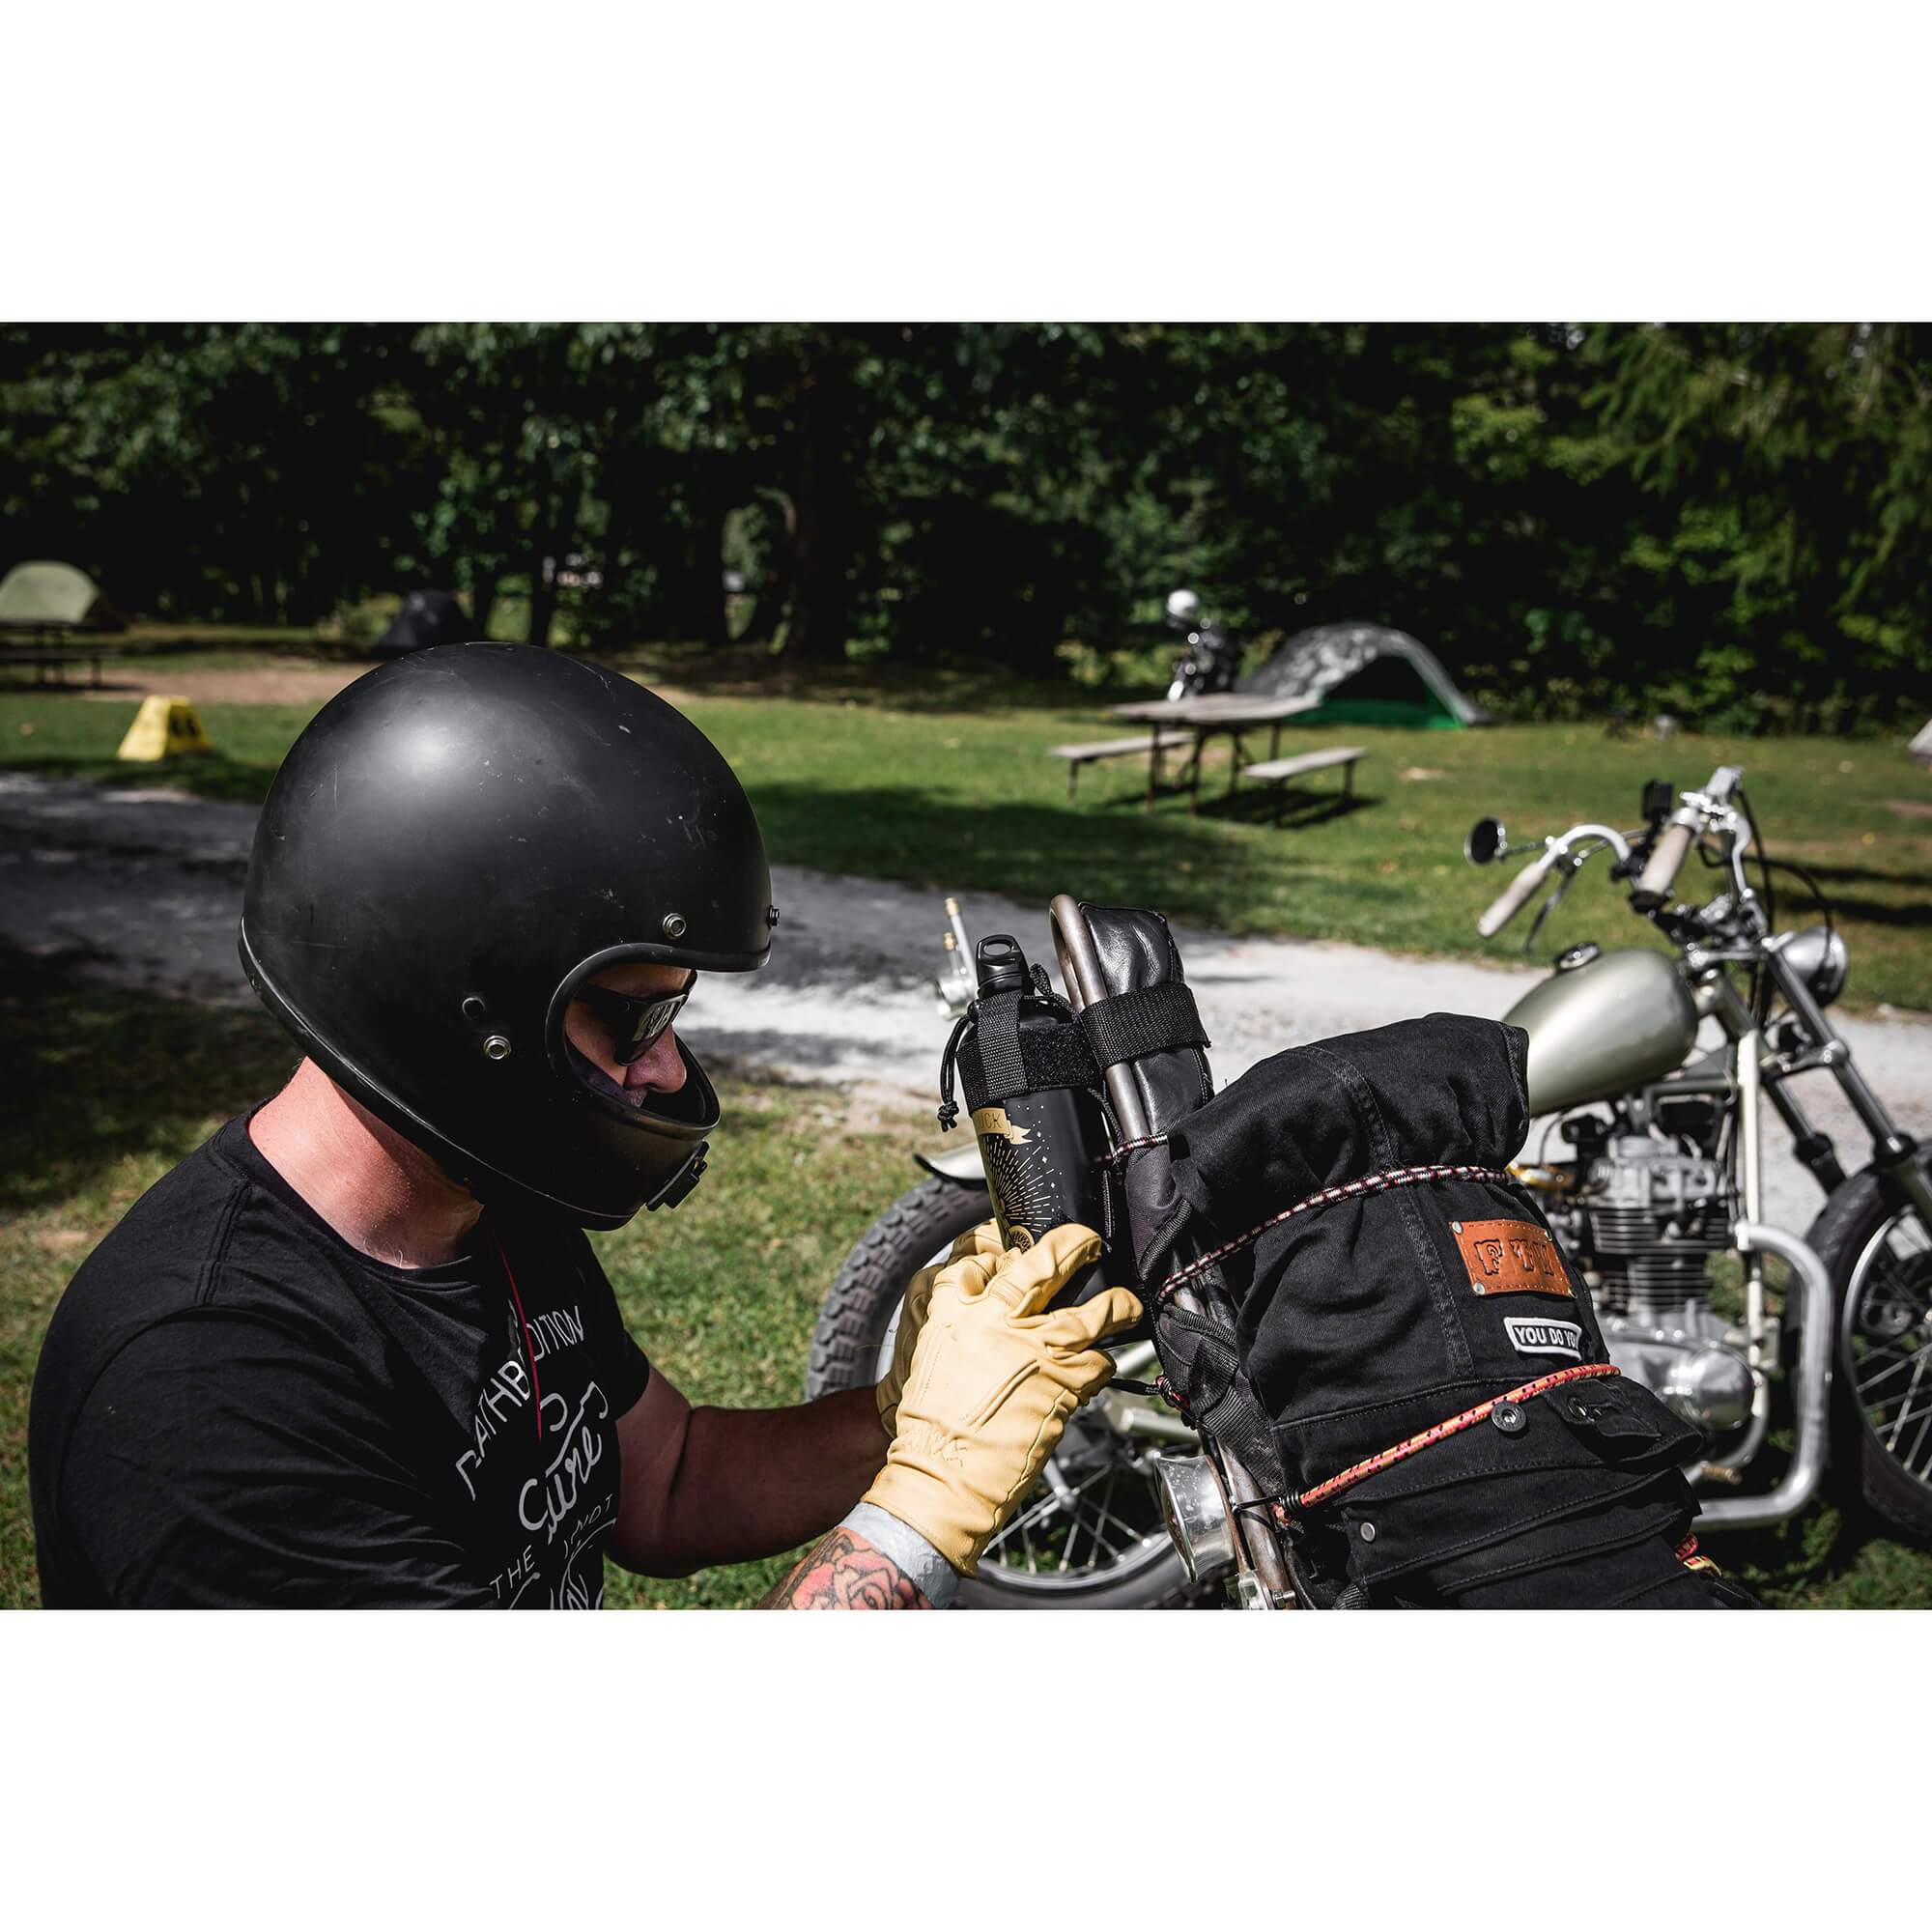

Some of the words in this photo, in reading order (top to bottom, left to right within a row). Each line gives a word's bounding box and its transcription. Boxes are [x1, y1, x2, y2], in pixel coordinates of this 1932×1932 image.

[1514, 1326, 1548, 1345] YOU
[1548, 1327, 1564, 1346] DO
[1563, 1330, 1577, 1349] YO
[489, 1545, 535, 1600] THE
